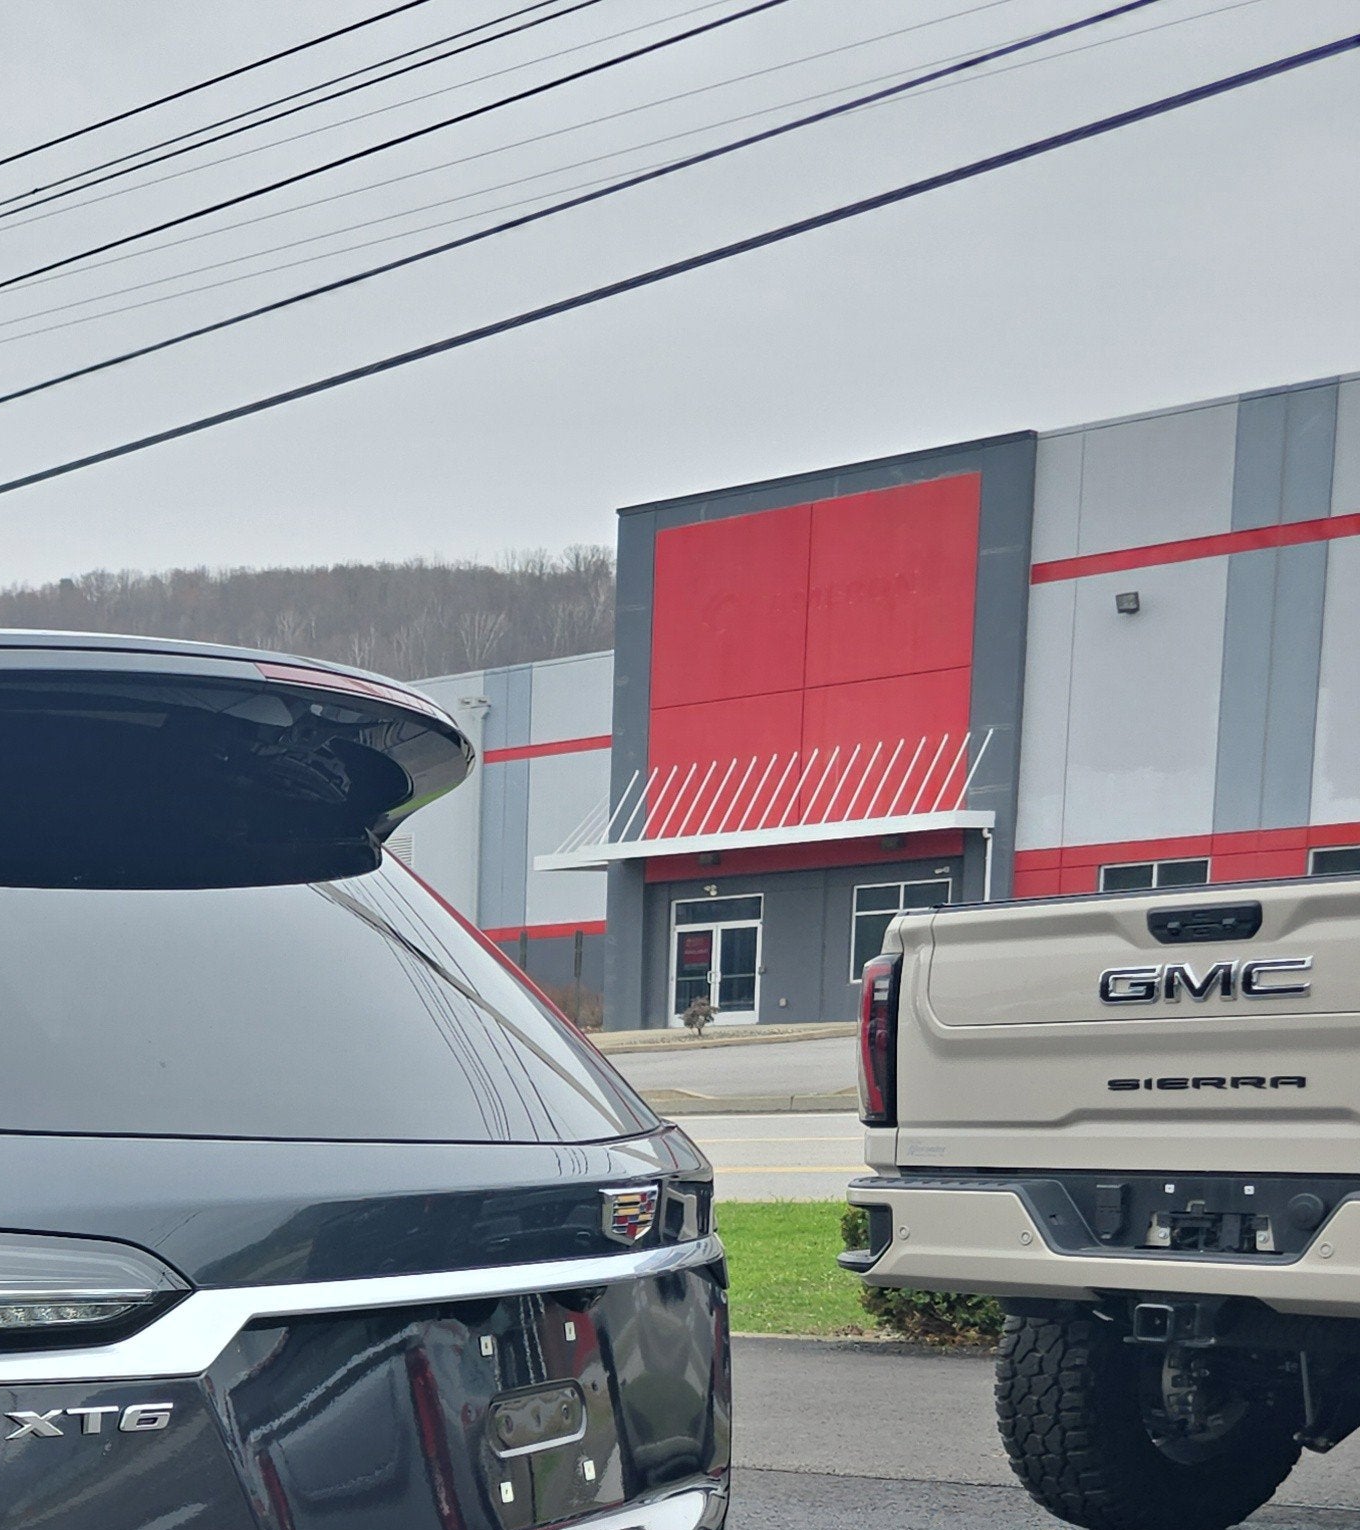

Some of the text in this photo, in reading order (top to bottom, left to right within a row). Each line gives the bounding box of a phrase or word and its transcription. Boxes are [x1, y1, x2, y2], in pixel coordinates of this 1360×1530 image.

[1099, 955, 1314, 1006] GMC
[1107, 1075, 1307, 1091] SIERRA
[3, 1402, 174, 1440] XT6
